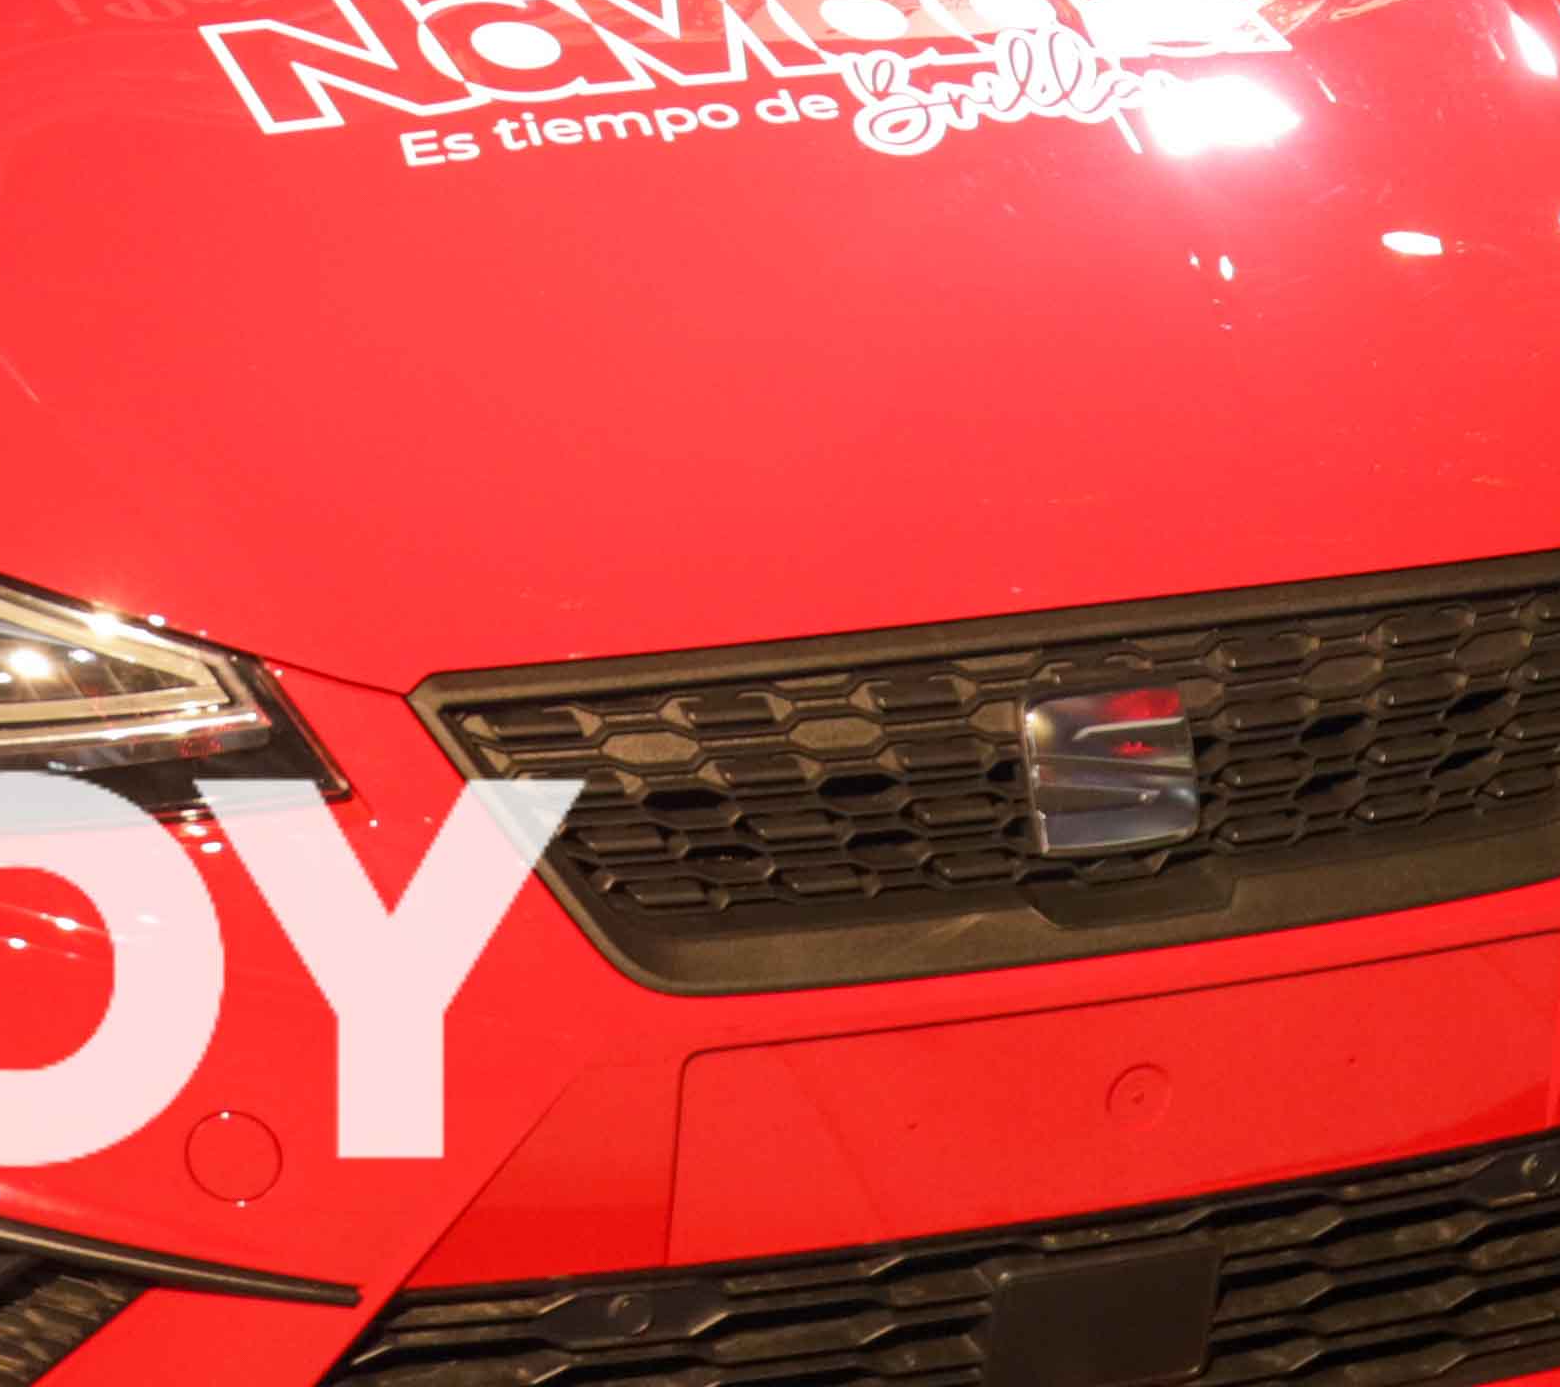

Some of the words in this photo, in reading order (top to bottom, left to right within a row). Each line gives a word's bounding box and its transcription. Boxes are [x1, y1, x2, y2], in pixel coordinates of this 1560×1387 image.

[399, 129, 480, 169] Es
[492, 99, 742, 159] tiempo
[754, 89, 839, 127] de
